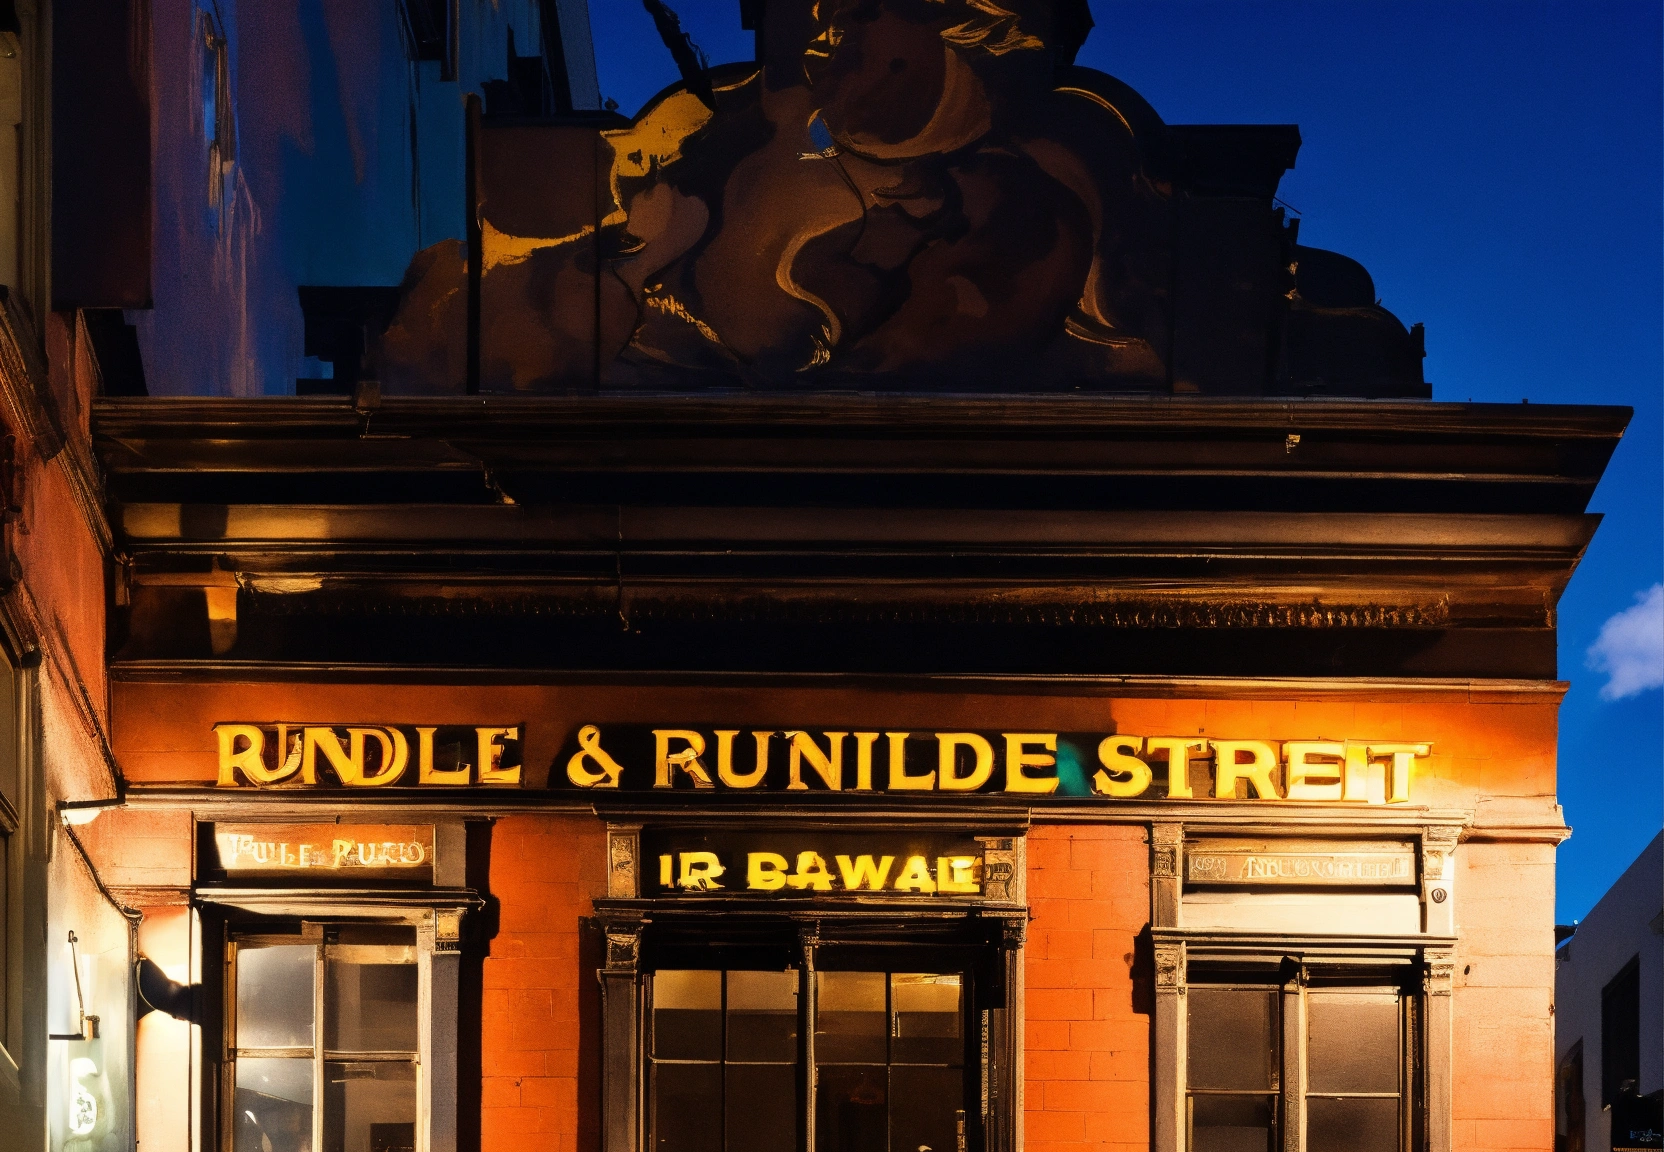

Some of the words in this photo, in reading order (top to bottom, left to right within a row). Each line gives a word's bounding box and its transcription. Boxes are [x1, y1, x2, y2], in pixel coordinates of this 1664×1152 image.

[215, 724, 522, 787] RUNDLE
[567, 725, 623, 788] &
[651, 729, 1060, 794] RUNILDE
